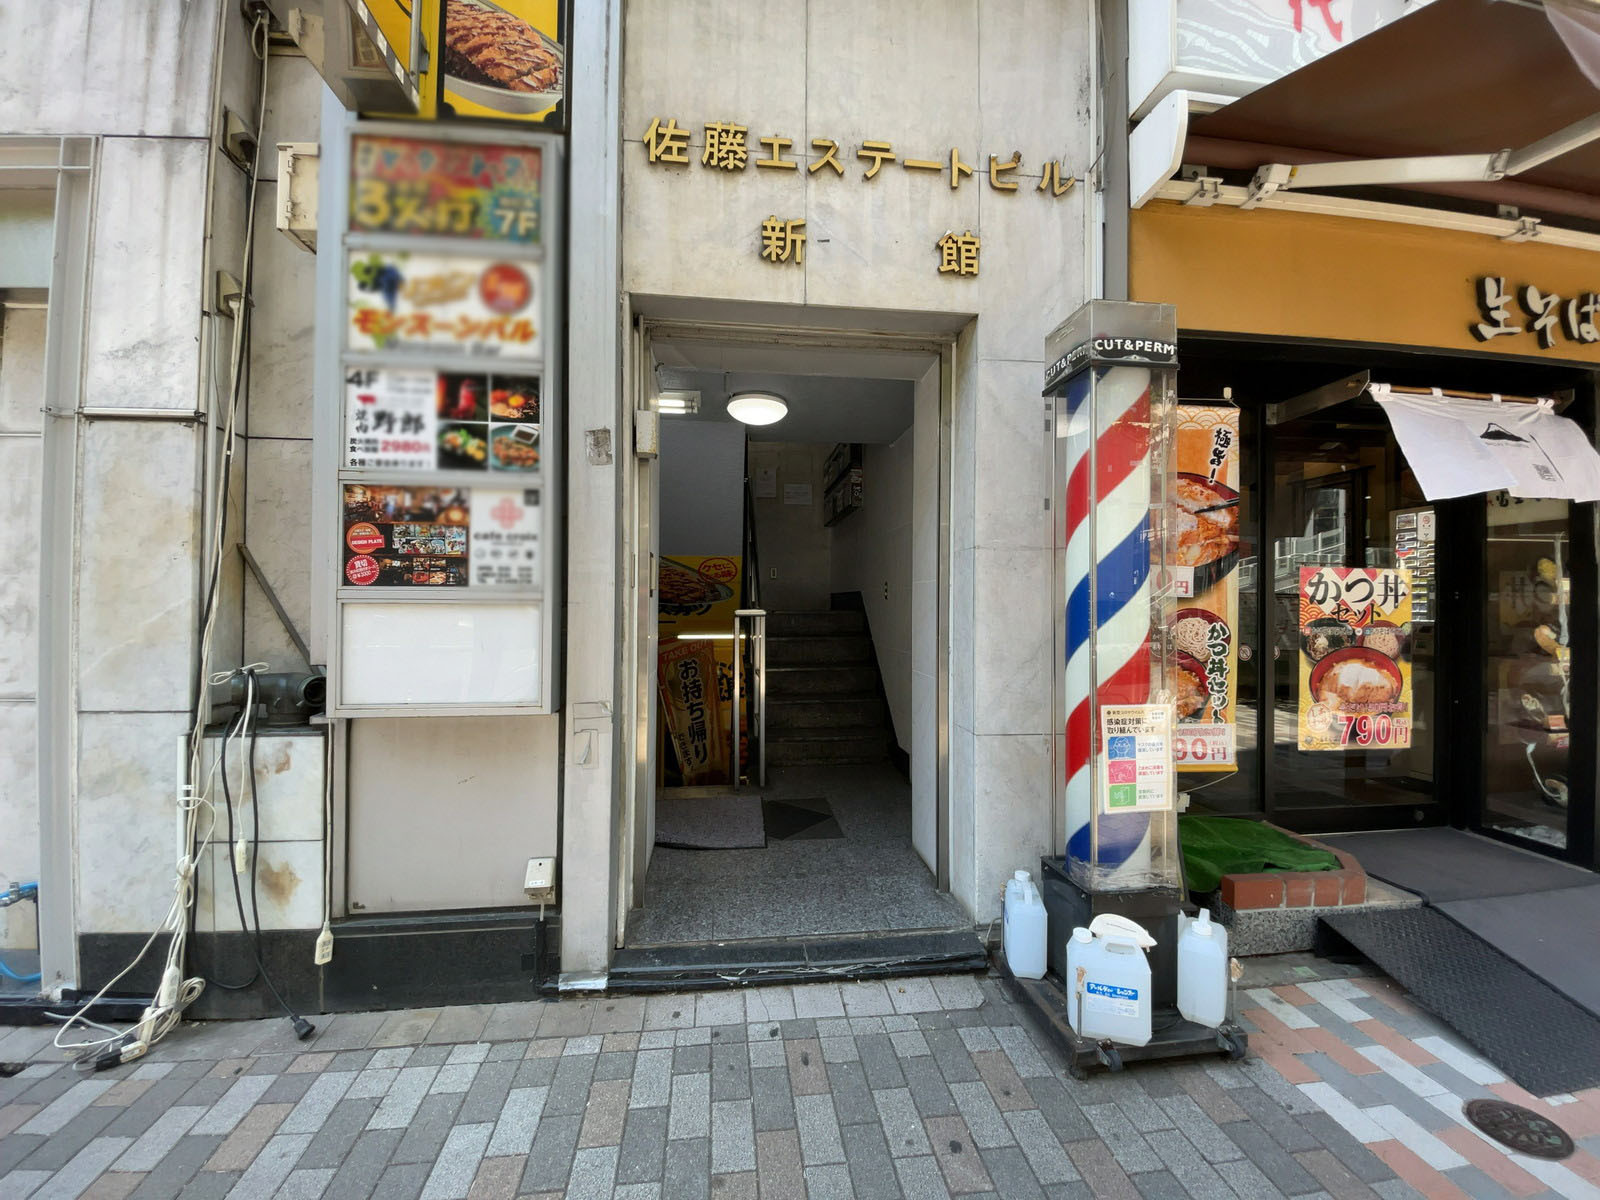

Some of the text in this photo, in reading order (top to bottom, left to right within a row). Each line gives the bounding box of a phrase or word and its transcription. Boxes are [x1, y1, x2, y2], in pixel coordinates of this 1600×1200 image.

[642, 116, 1077, 197] 佐藤エステートビル
[1094, 339, 1175, 355] CUT&PERM
[1308, 571, 1406, 610] かつ丼
[1332, 603, 1381, 625] セット
[1207, 622, 1229, 724] かつ丼セット
[679, 659, 707, 765] お持ち帰り
[1106, 717, 1148, 727] 感染症対策に
[1107, 726, 1156, 735] 取り組んでいます
